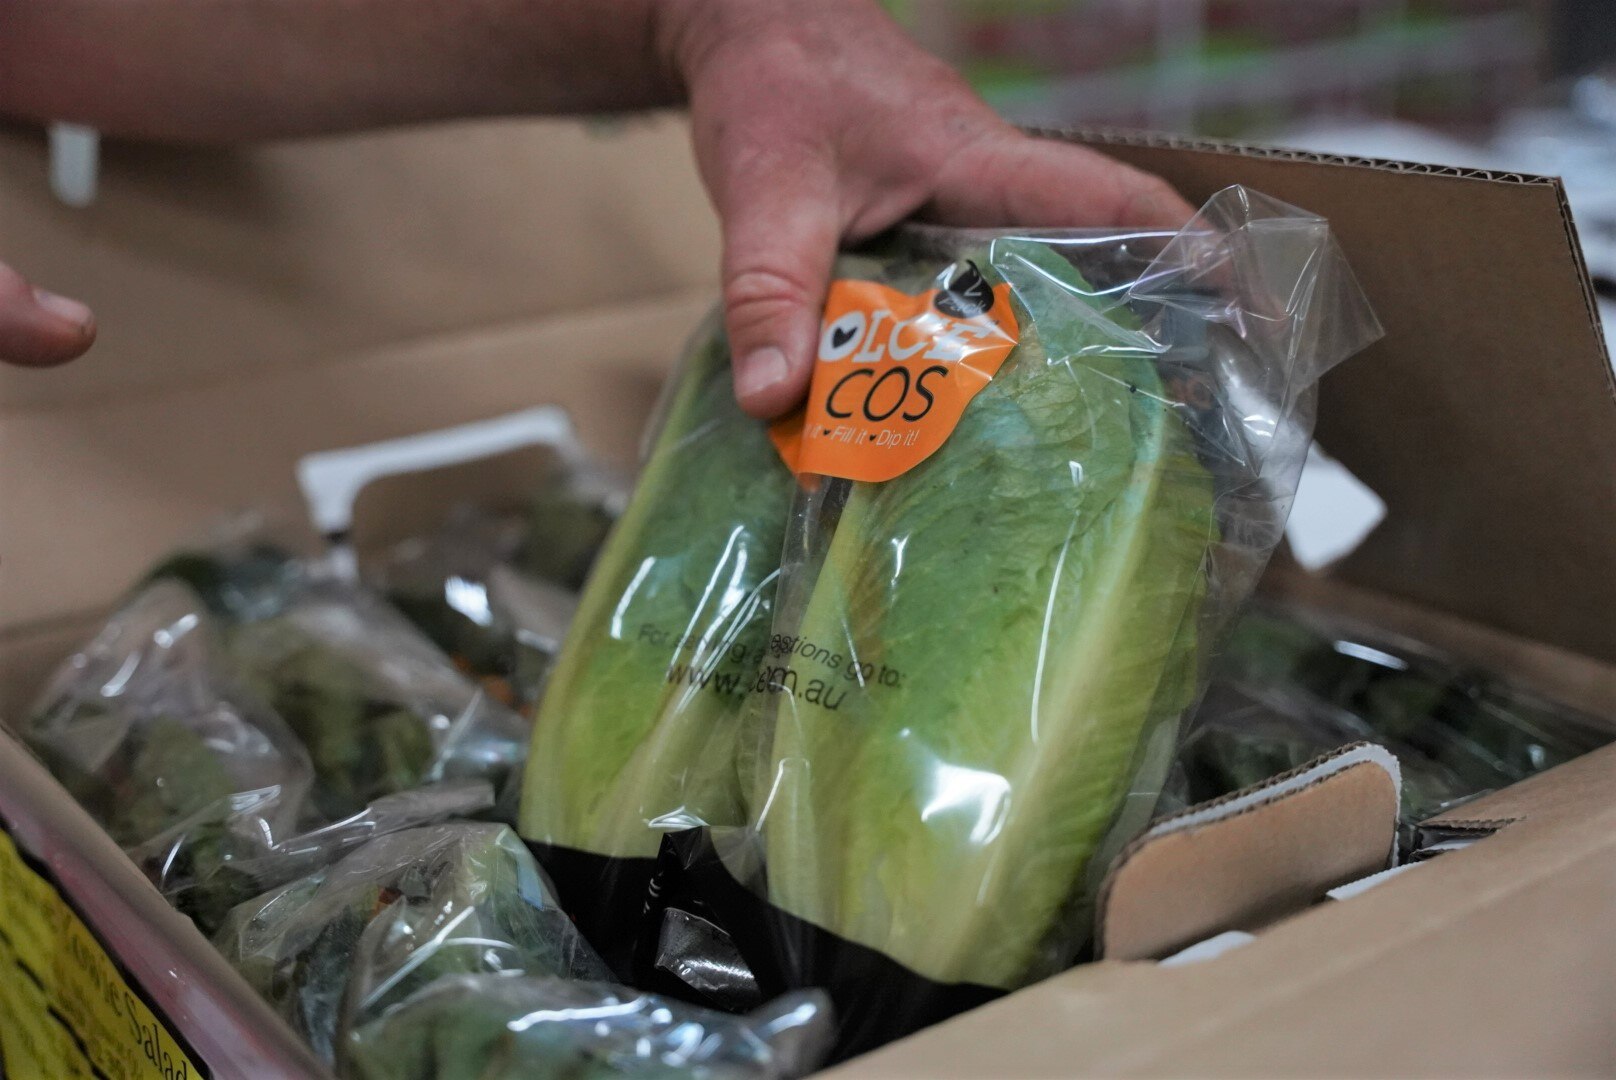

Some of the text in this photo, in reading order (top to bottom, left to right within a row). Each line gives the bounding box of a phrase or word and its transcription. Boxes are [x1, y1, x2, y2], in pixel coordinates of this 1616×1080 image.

[818, 310, 996, 363] OLCE
[825, 365, 949, 422] COS
[830, 424, 856, 444] Fill
[855, 429, 868, 444] it
[875, 429, 902, 449] Dip
[903, 429, 920, 446] it!
[124, 991, 188, 1080] Salad
